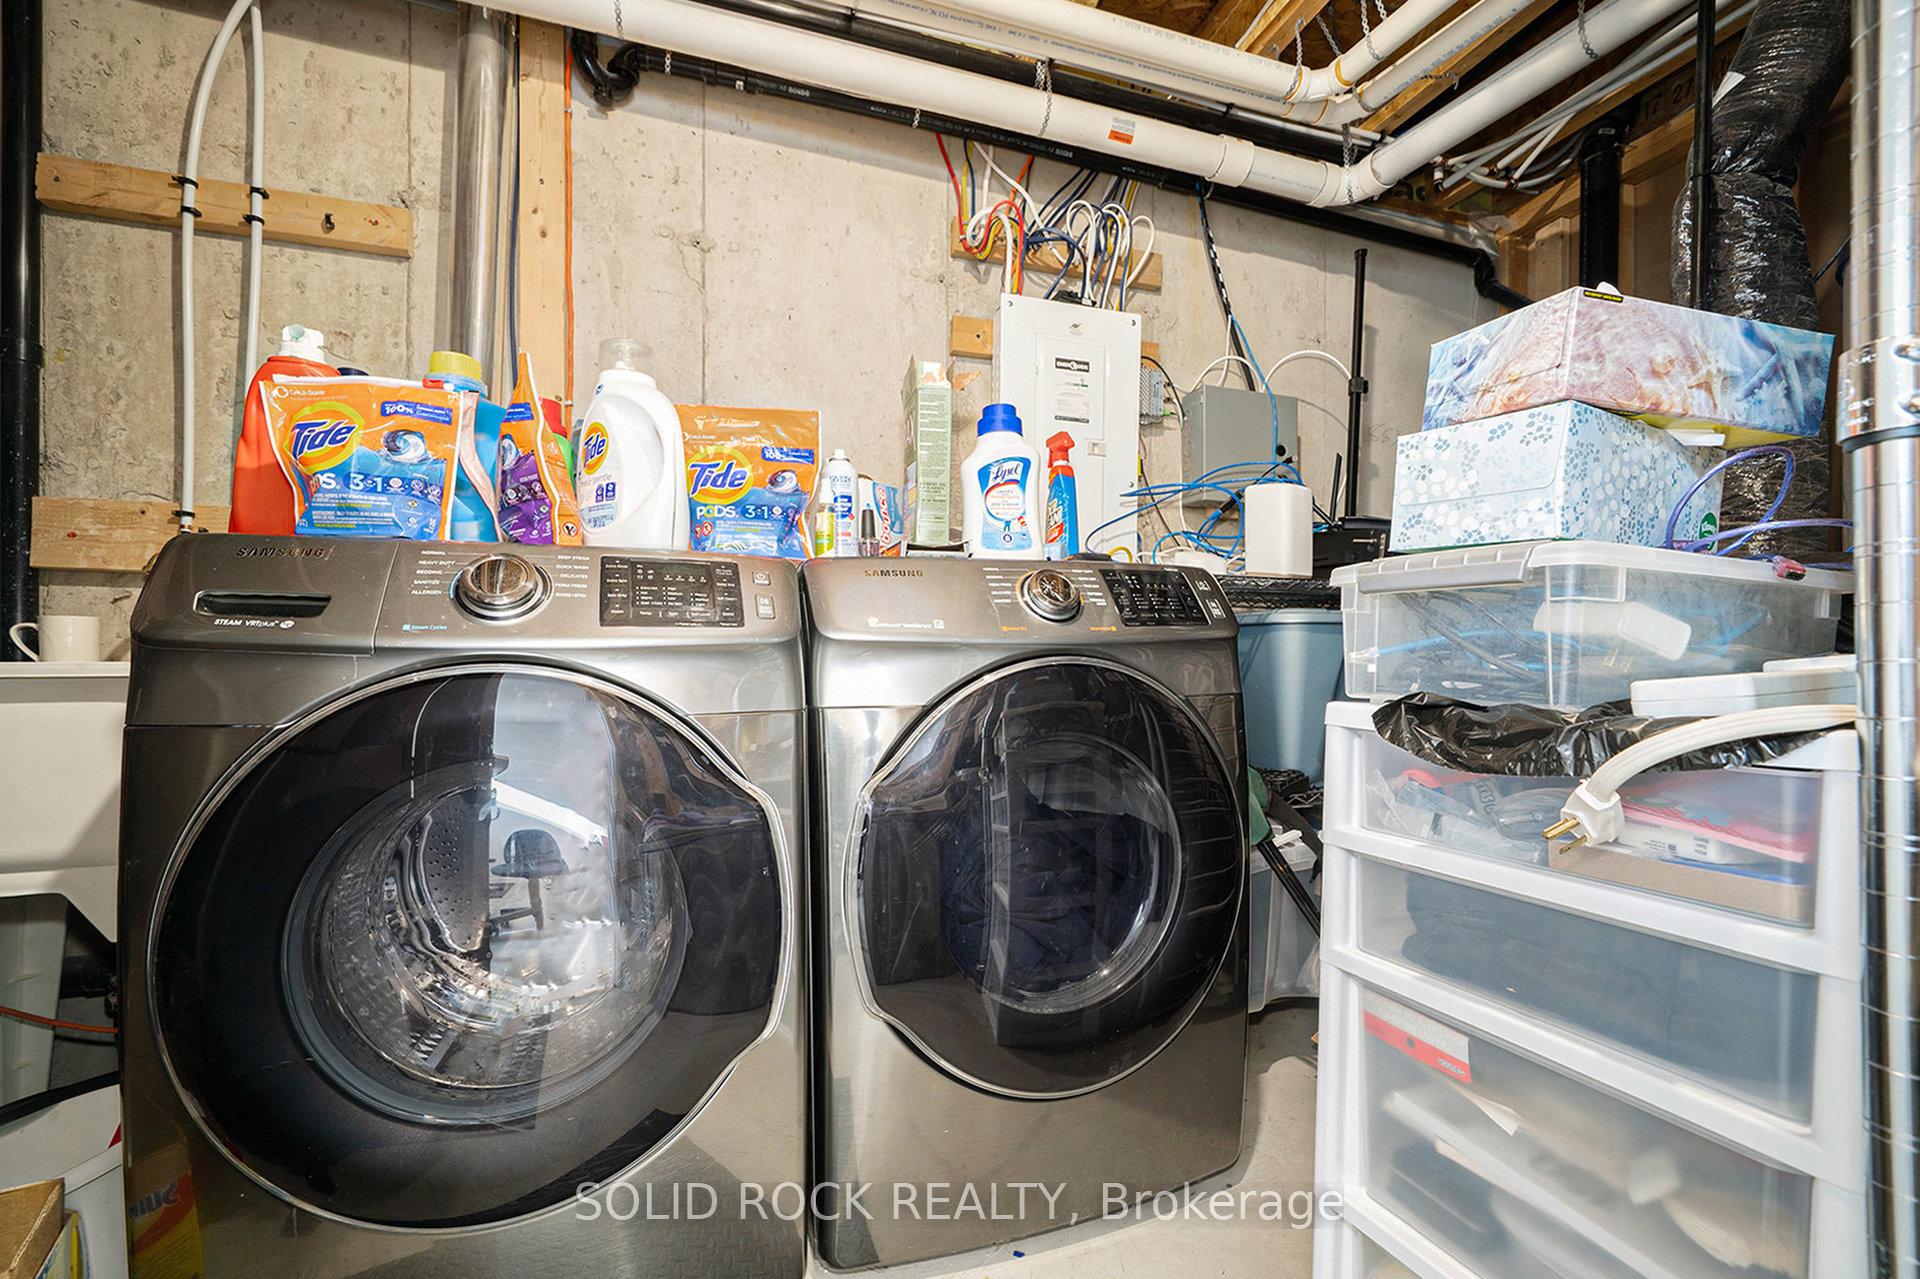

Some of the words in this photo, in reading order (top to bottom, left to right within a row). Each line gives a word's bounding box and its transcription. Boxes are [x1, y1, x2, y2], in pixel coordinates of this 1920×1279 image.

[291, 419, 357, 462] Tide
[584, 433, 607, 469] Tide
[688, 460, 750, 497] Tide
[991, 463, 1021, 482] Lysol
[236, 547, 326, 558] SAMSUNG
[864, 569, 924, 578] SAMSUNG
[214, 618, 242, 626] STEAM
